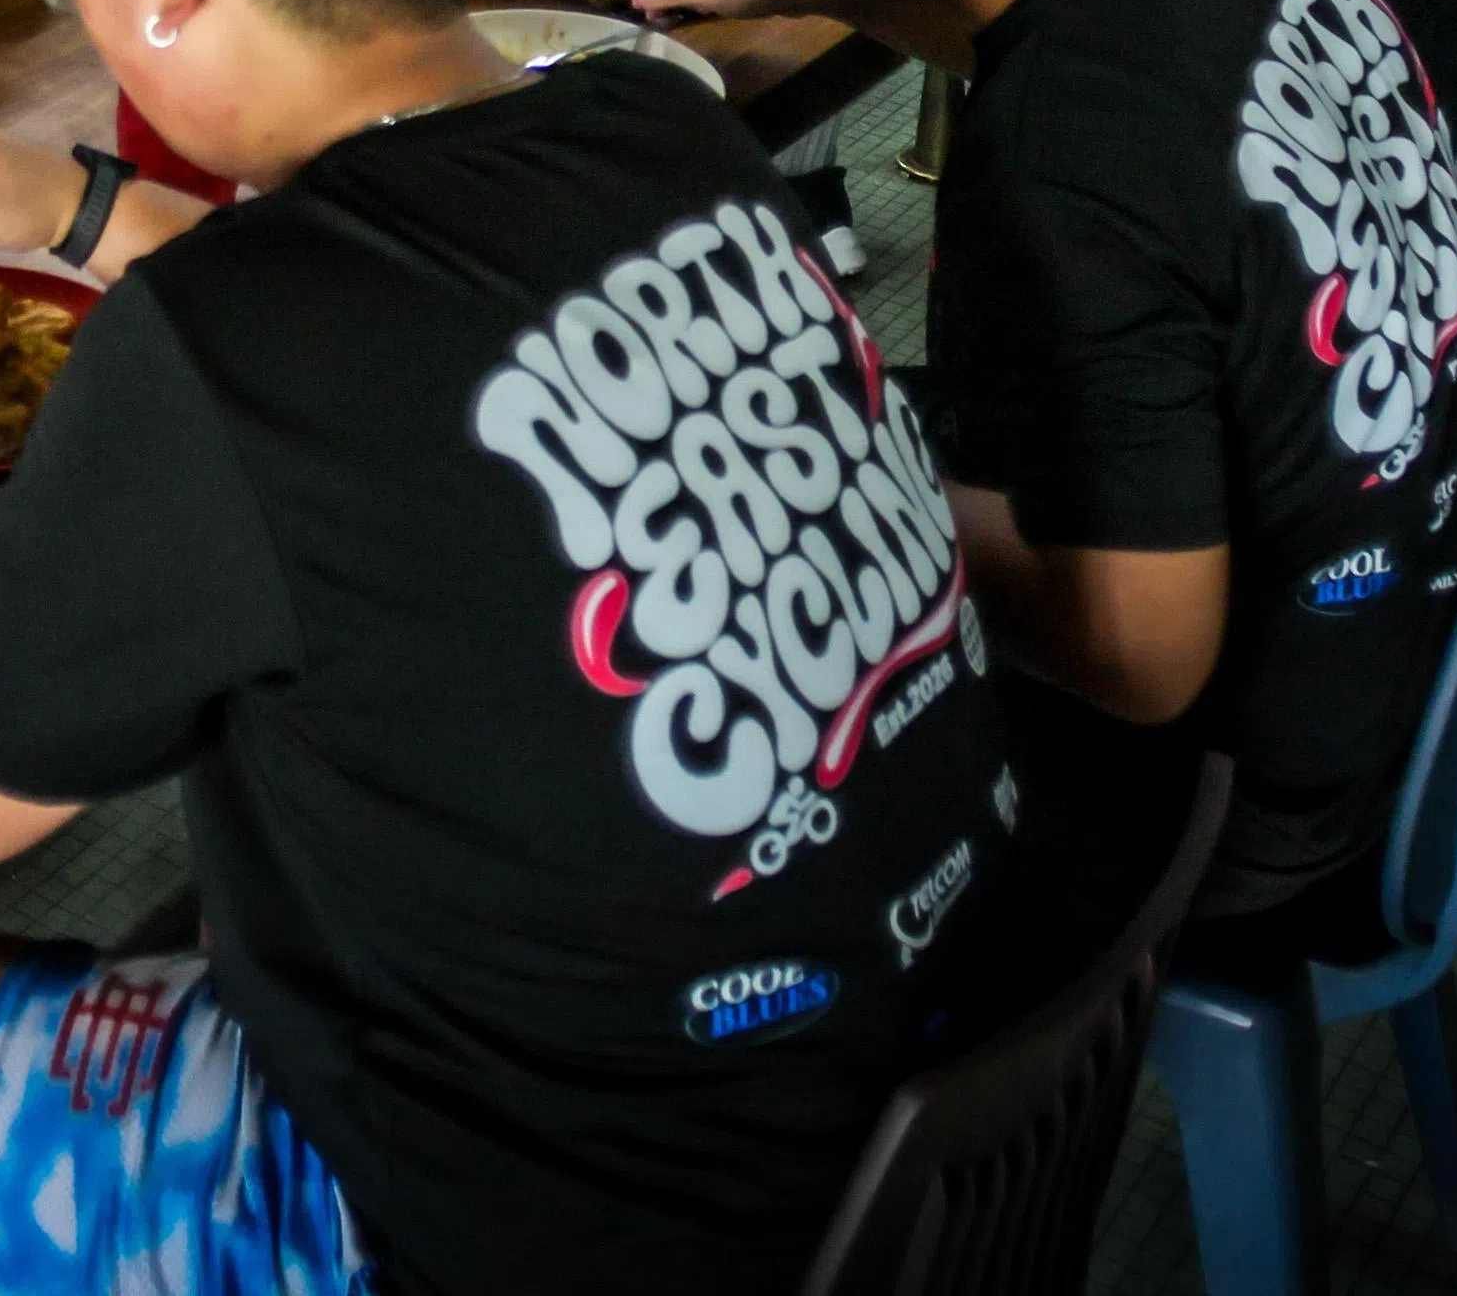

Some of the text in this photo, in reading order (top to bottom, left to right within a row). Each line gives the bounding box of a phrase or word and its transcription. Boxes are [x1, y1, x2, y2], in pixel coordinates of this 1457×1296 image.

[1335, 49, 1435, 333] EAST
[476, 204, 836, 570] NORTH
[613, 324, 871, 660] EAST
[628, 378, 958, 837] CYCLING
[691, 964, 804, 1011] COOL
